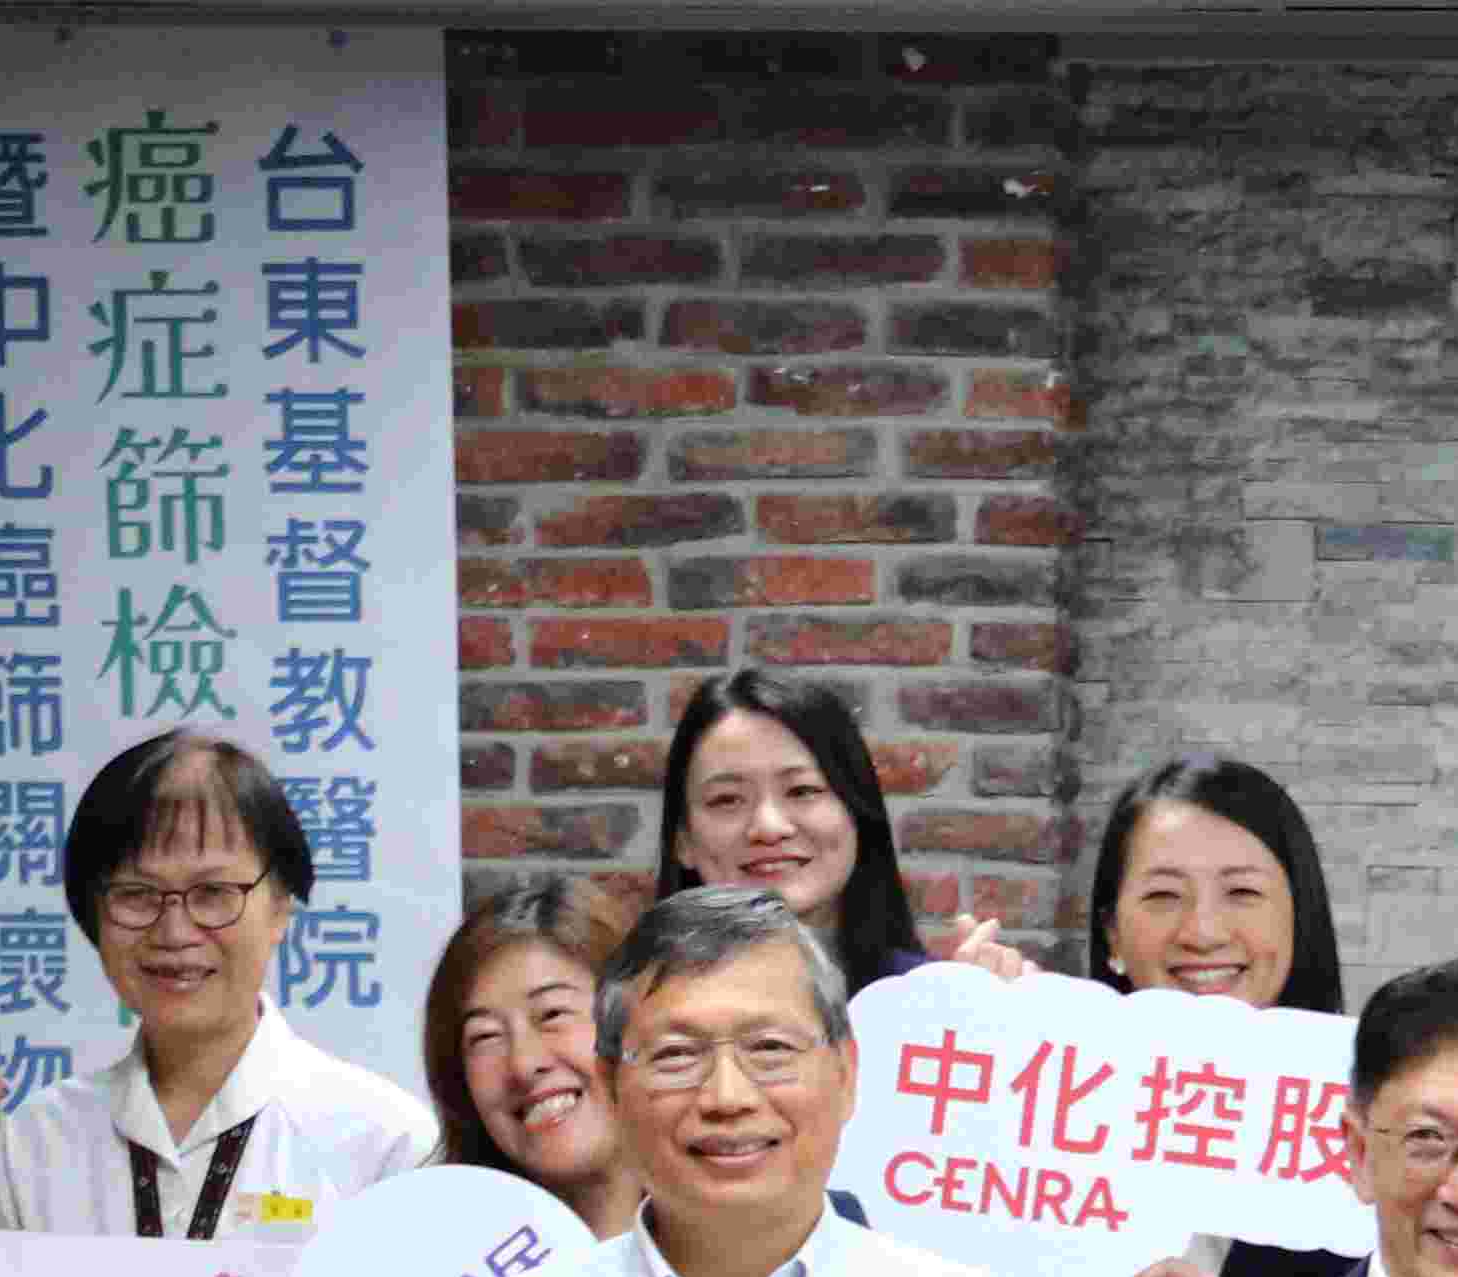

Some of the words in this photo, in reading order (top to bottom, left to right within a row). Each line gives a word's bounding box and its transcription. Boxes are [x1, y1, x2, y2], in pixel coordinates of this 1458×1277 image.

[85, 108, 237, 722] 癌症篩檢
[258, 122, 382, 1010] 台東基督教醫院
[883, 1150, 1129, 1233] CENRA
[896, 1029, 1353, 1184] 中化控股
